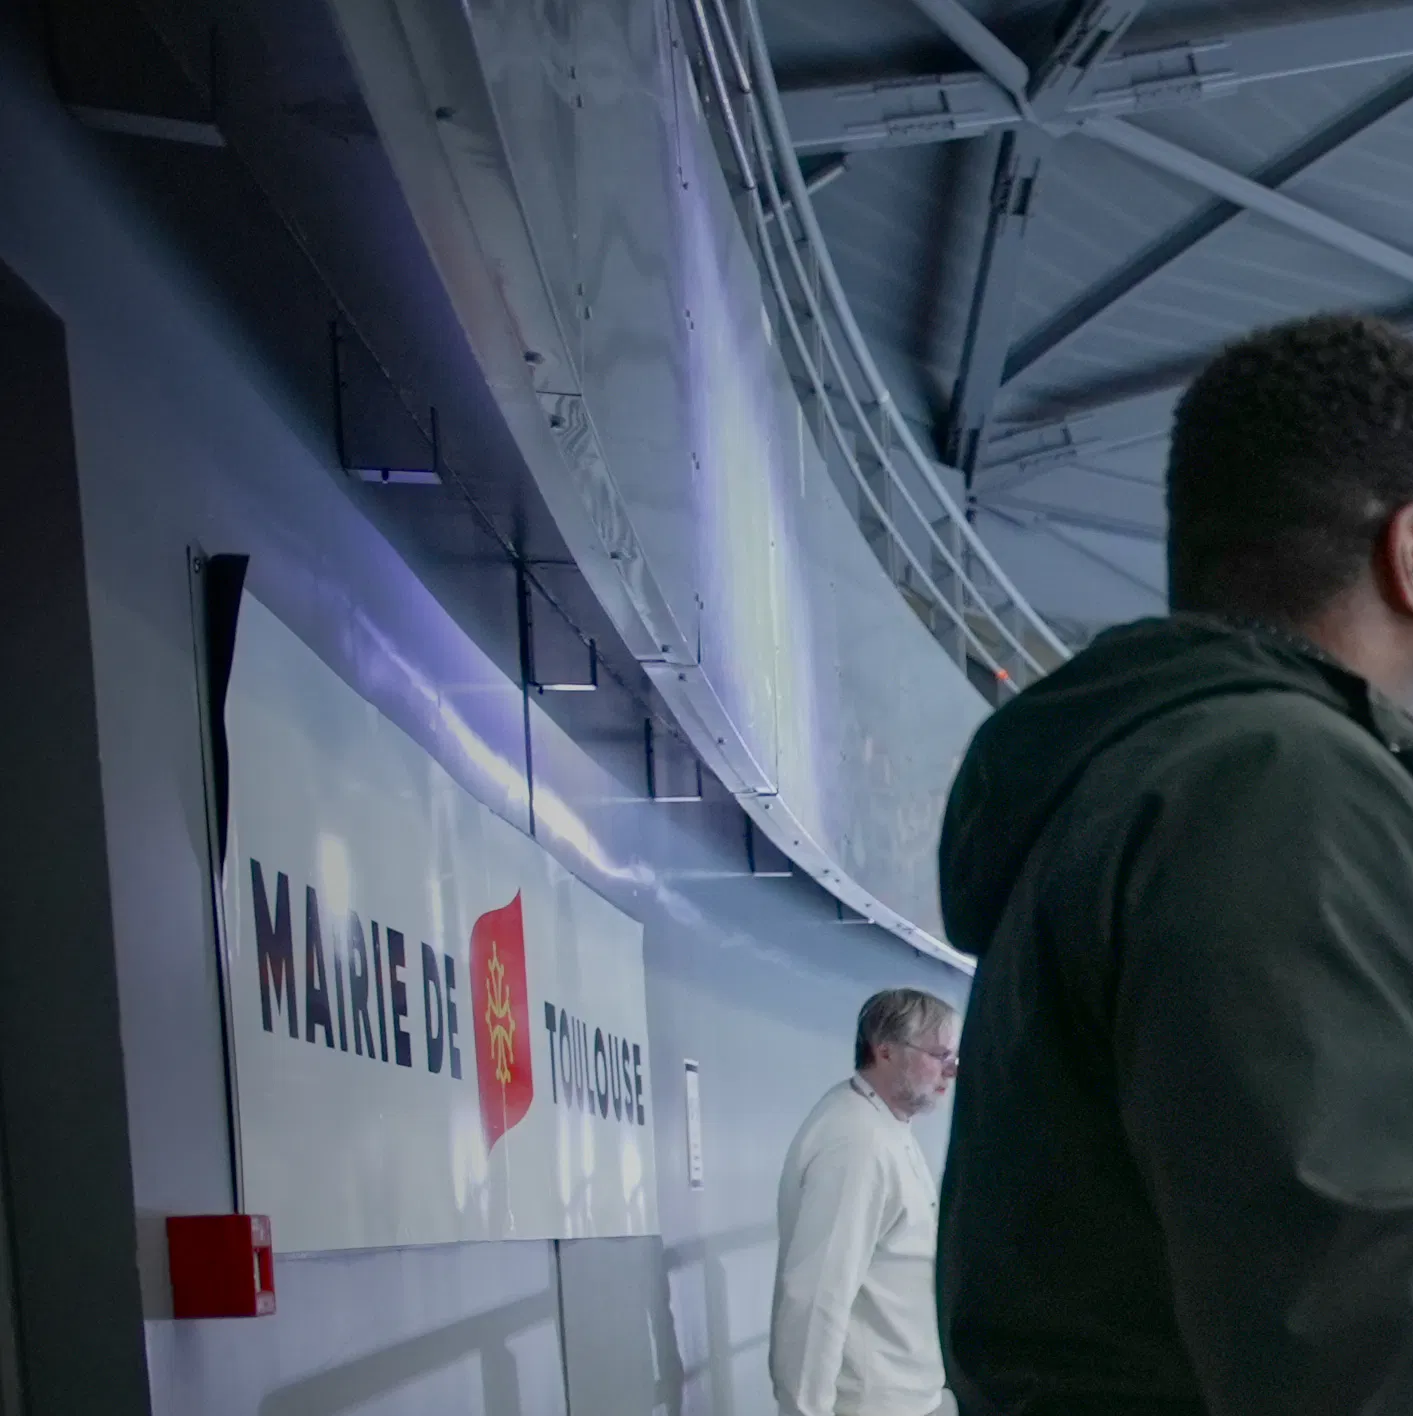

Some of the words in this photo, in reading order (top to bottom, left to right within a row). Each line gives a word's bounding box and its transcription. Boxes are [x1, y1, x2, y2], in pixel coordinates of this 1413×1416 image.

[250, 857, 412, 1068] MAIRIE
[421, 941, 463, 1080] DE
[544, 1001, 645, 1126] TOULOUSE
